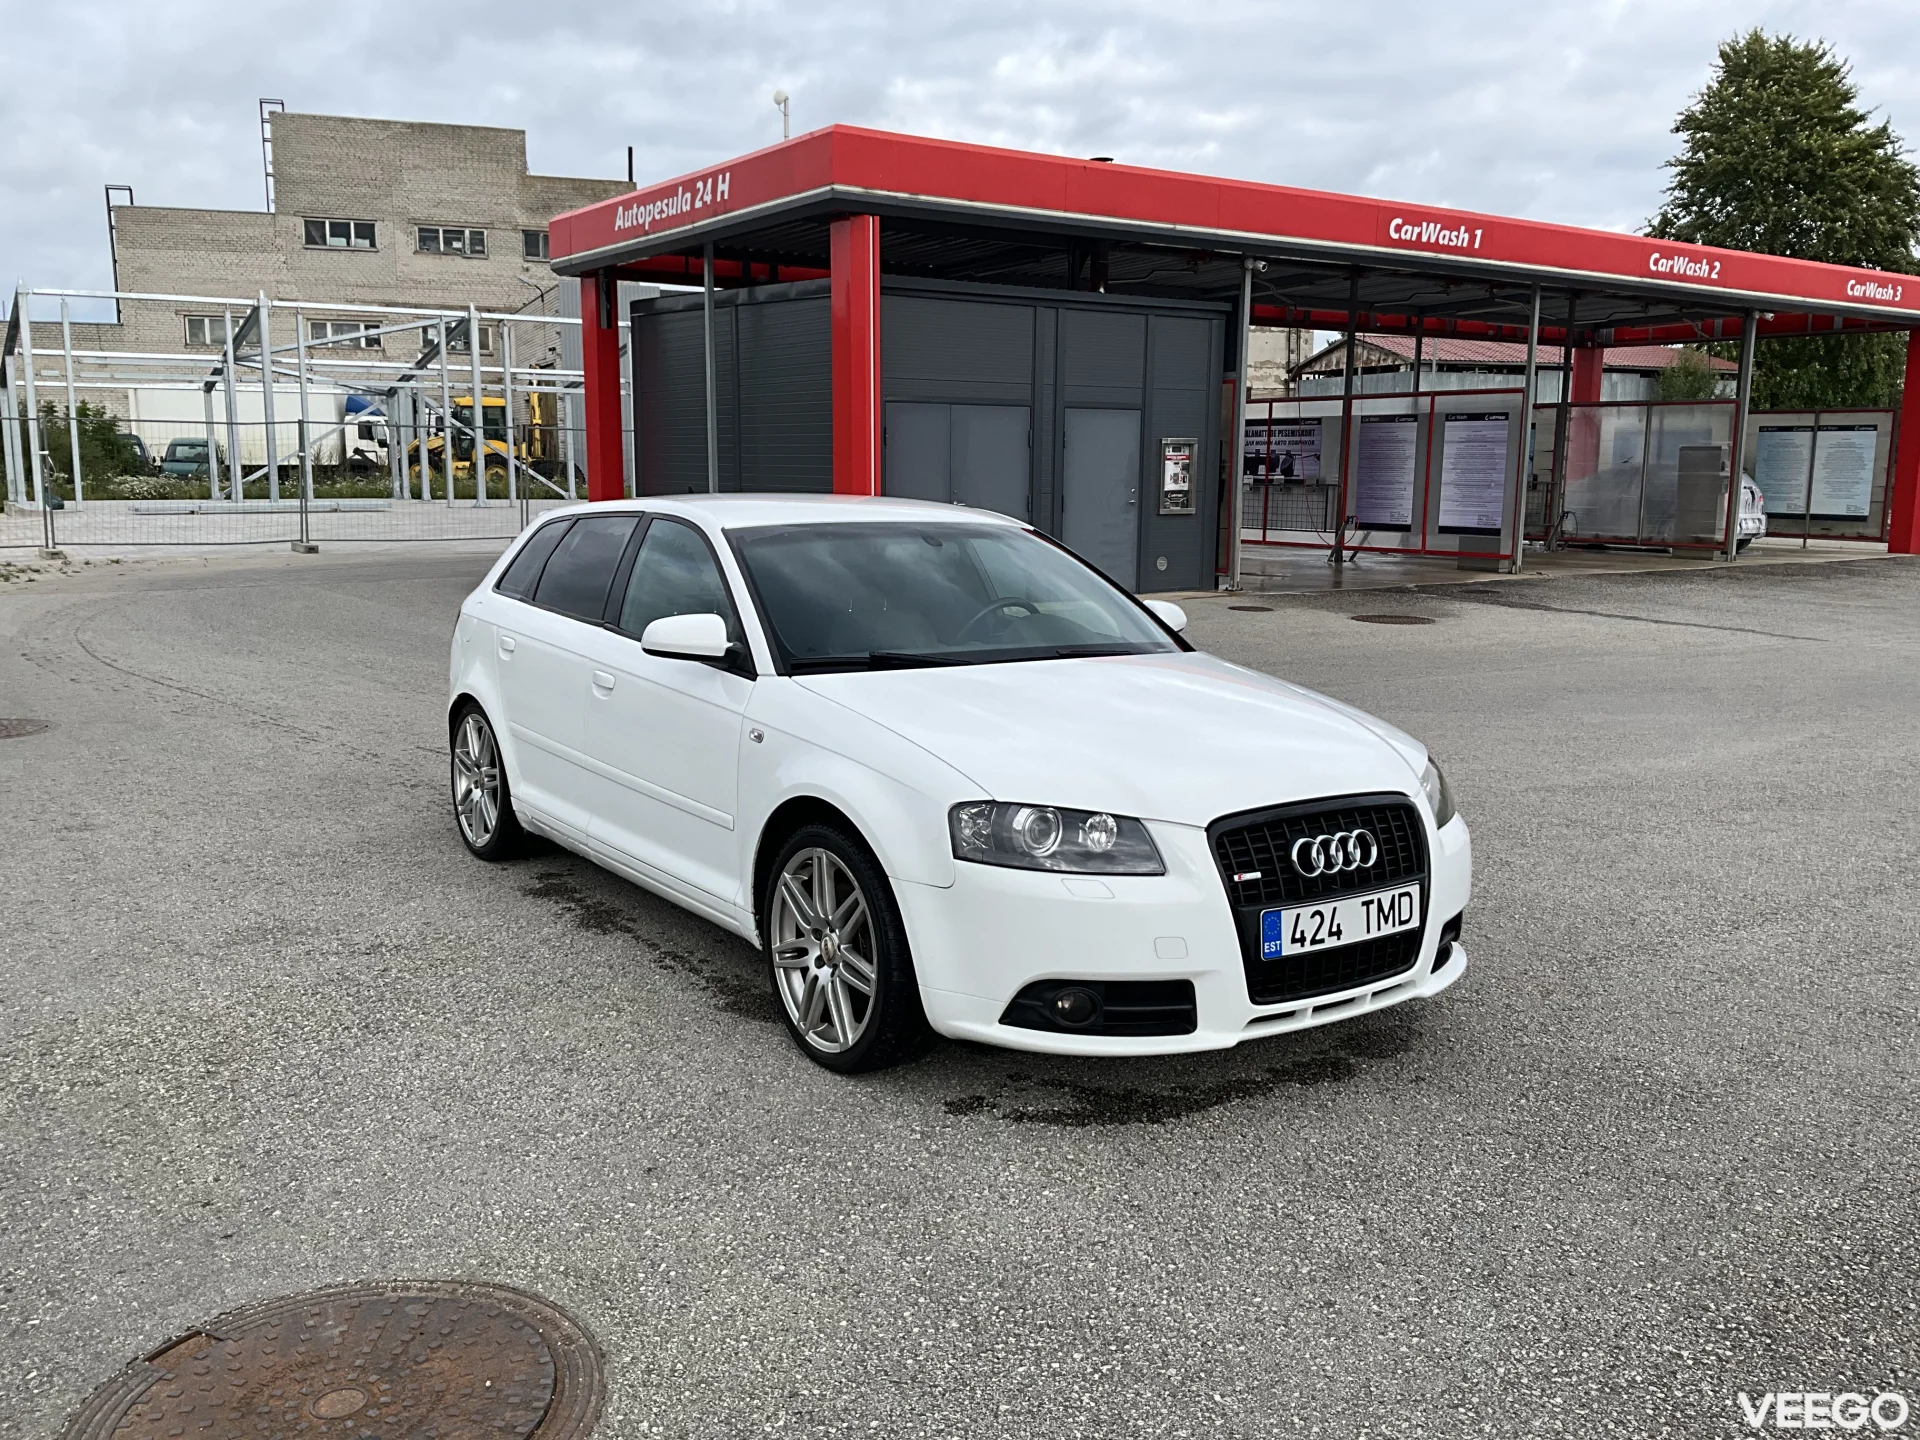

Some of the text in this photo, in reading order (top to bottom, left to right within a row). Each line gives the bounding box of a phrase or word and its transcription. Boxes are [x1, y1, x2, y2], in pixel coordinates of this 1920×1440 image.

[614, 172, 731, 231] Autopesula 24 H
[1389, 217, 1483, 249] CarWash 1
[1649, 252, 1721, 279] CarWash 2
[1847, 279, 1903, 301] CarWash 3
[1290, 891, 1413, 948] 424 TMD
[1264, 940, 1281, 952] EST
